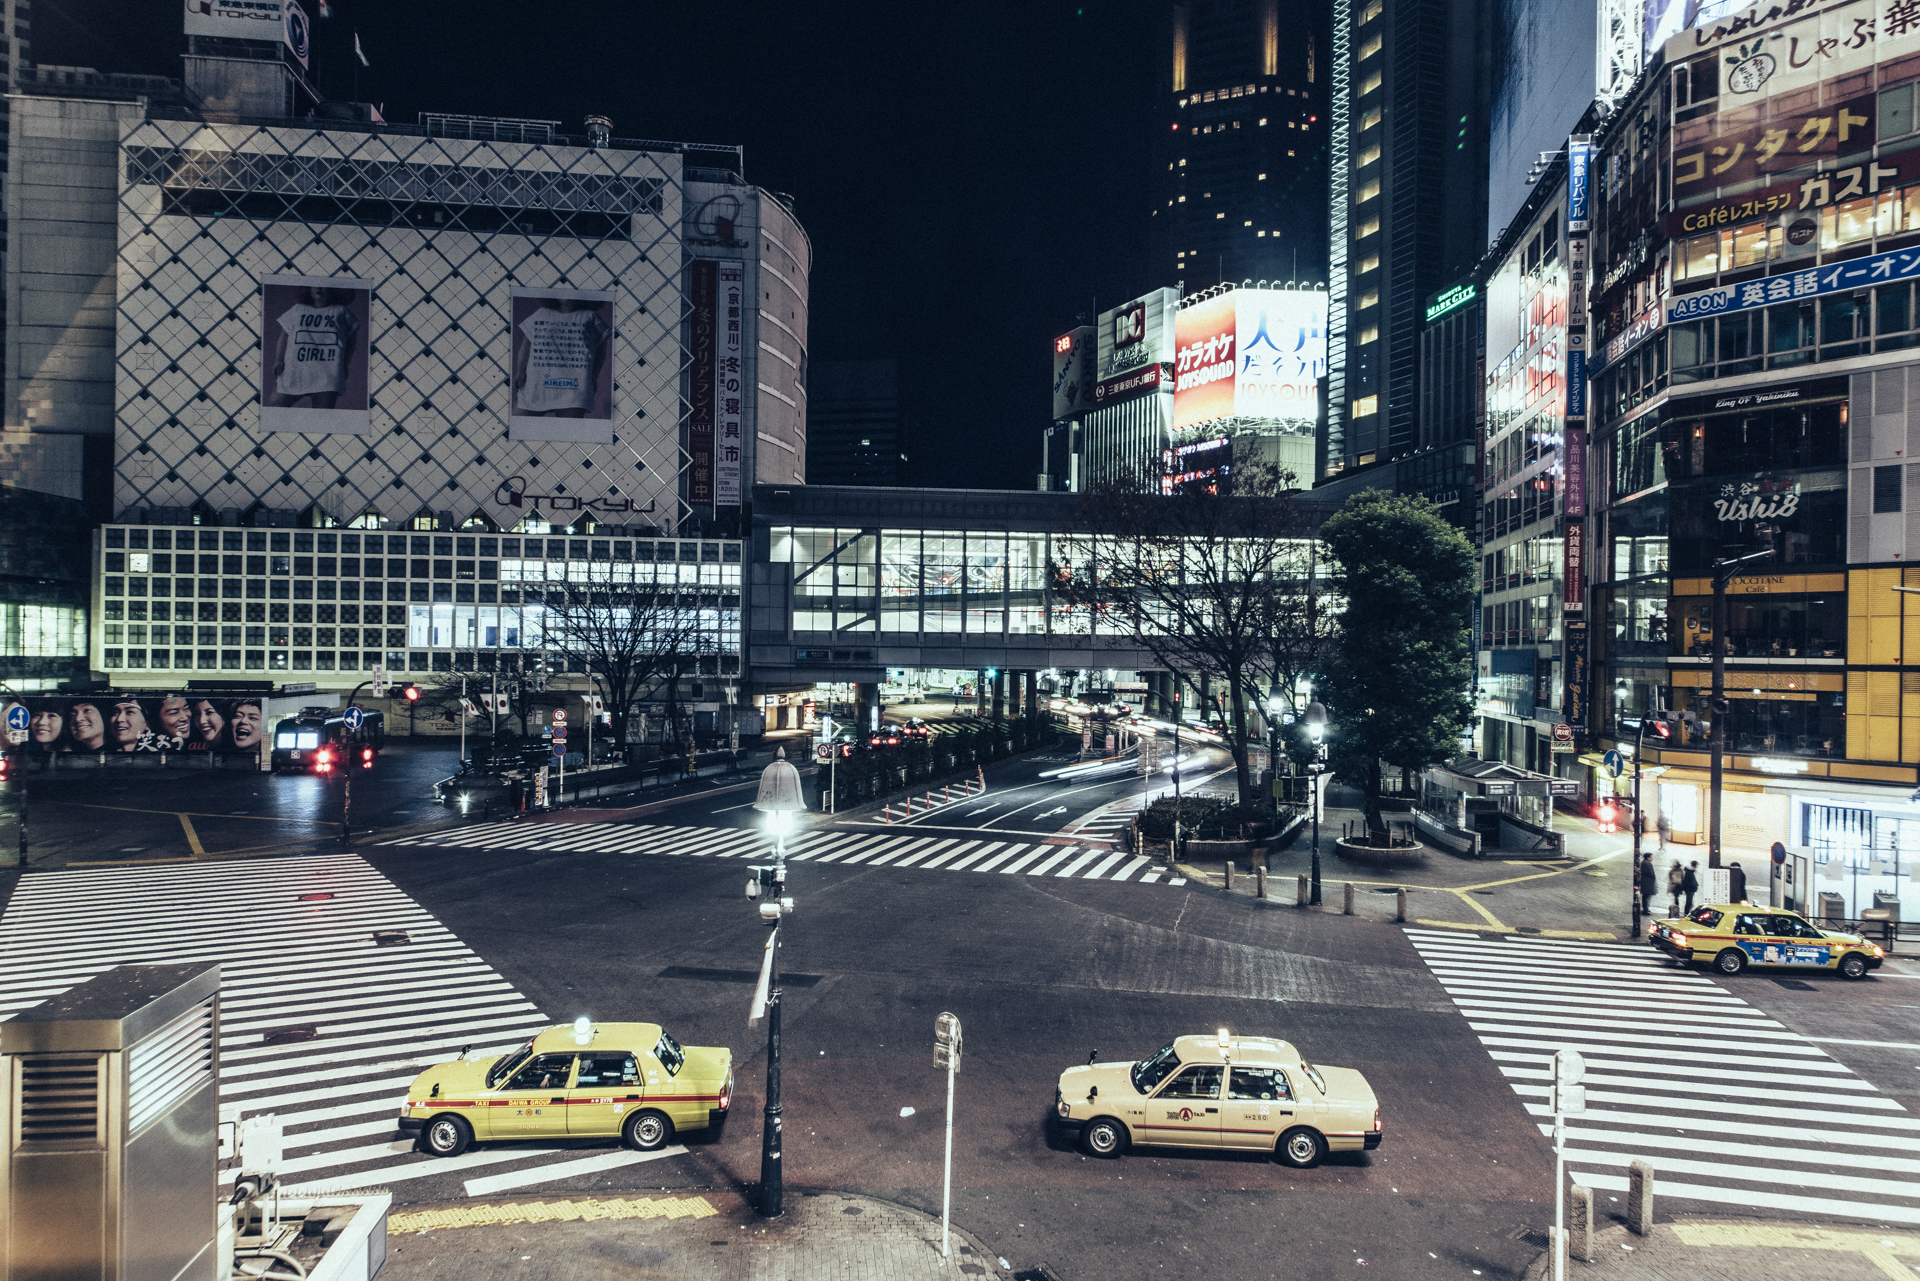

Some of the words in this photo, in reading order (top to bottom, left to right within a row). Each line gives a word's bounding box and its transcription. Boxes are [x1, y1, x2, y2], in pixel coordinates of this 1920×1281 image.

[213, 9, 281, 21] TOKYU
[1675, 107, 1869, 185] コンタクト
[1572, 154, 1586, 218] 東急リバブル
[1799, 161, 1898, 211] ガスト
[1573, 221, 1584, 229] 9F
[1790, 227, 1814, 241] ガスト
[1571, 260, 1584, 315] 献血ルーム
[1741, 254, 1920, 306] 英会話イーオン
[1427, 298, 1452, 318] MARK
[1452, 284, 1475, 303] CITY
[1674, 291, 1727, 317] AEON
[299, 313, 336, 328] 100%
[1572, 317, 1582, 325] 6F
[297, 346, 336, 362] GIRL!!
[696, 306, 711, 420] 冬のクリアランス
[1177, 332, 1234, 373] カラオケ
[1108, 371, 1156, 396] 三菱東京UFJ銀行
[1176, 359, 1235, 392] JOYSOUND
[1715, 398, 1736, 408] King
[691, 424, 713, 432] SALE
[694, 452, 708, 497] 開催中
[1569, 444, 1581, 502] 品川美容外科
[1434, 489, 1460, 504] CITY
[1720, 482, 1753, 497] 渋谷
[521, 495, 656, 512] TOKYU
[1568, 506, 1581, 514] 4F
[1713, 494, 1800, 522] Ushi8
[1568, 525, 1581, 568] 外貨両替
[1745, 585, 1765, 593] Café
[1569, 682, 1582, 723] Garden
[136, 730, 184, 751] 笑おう
[188, 741, 209, 750] au
